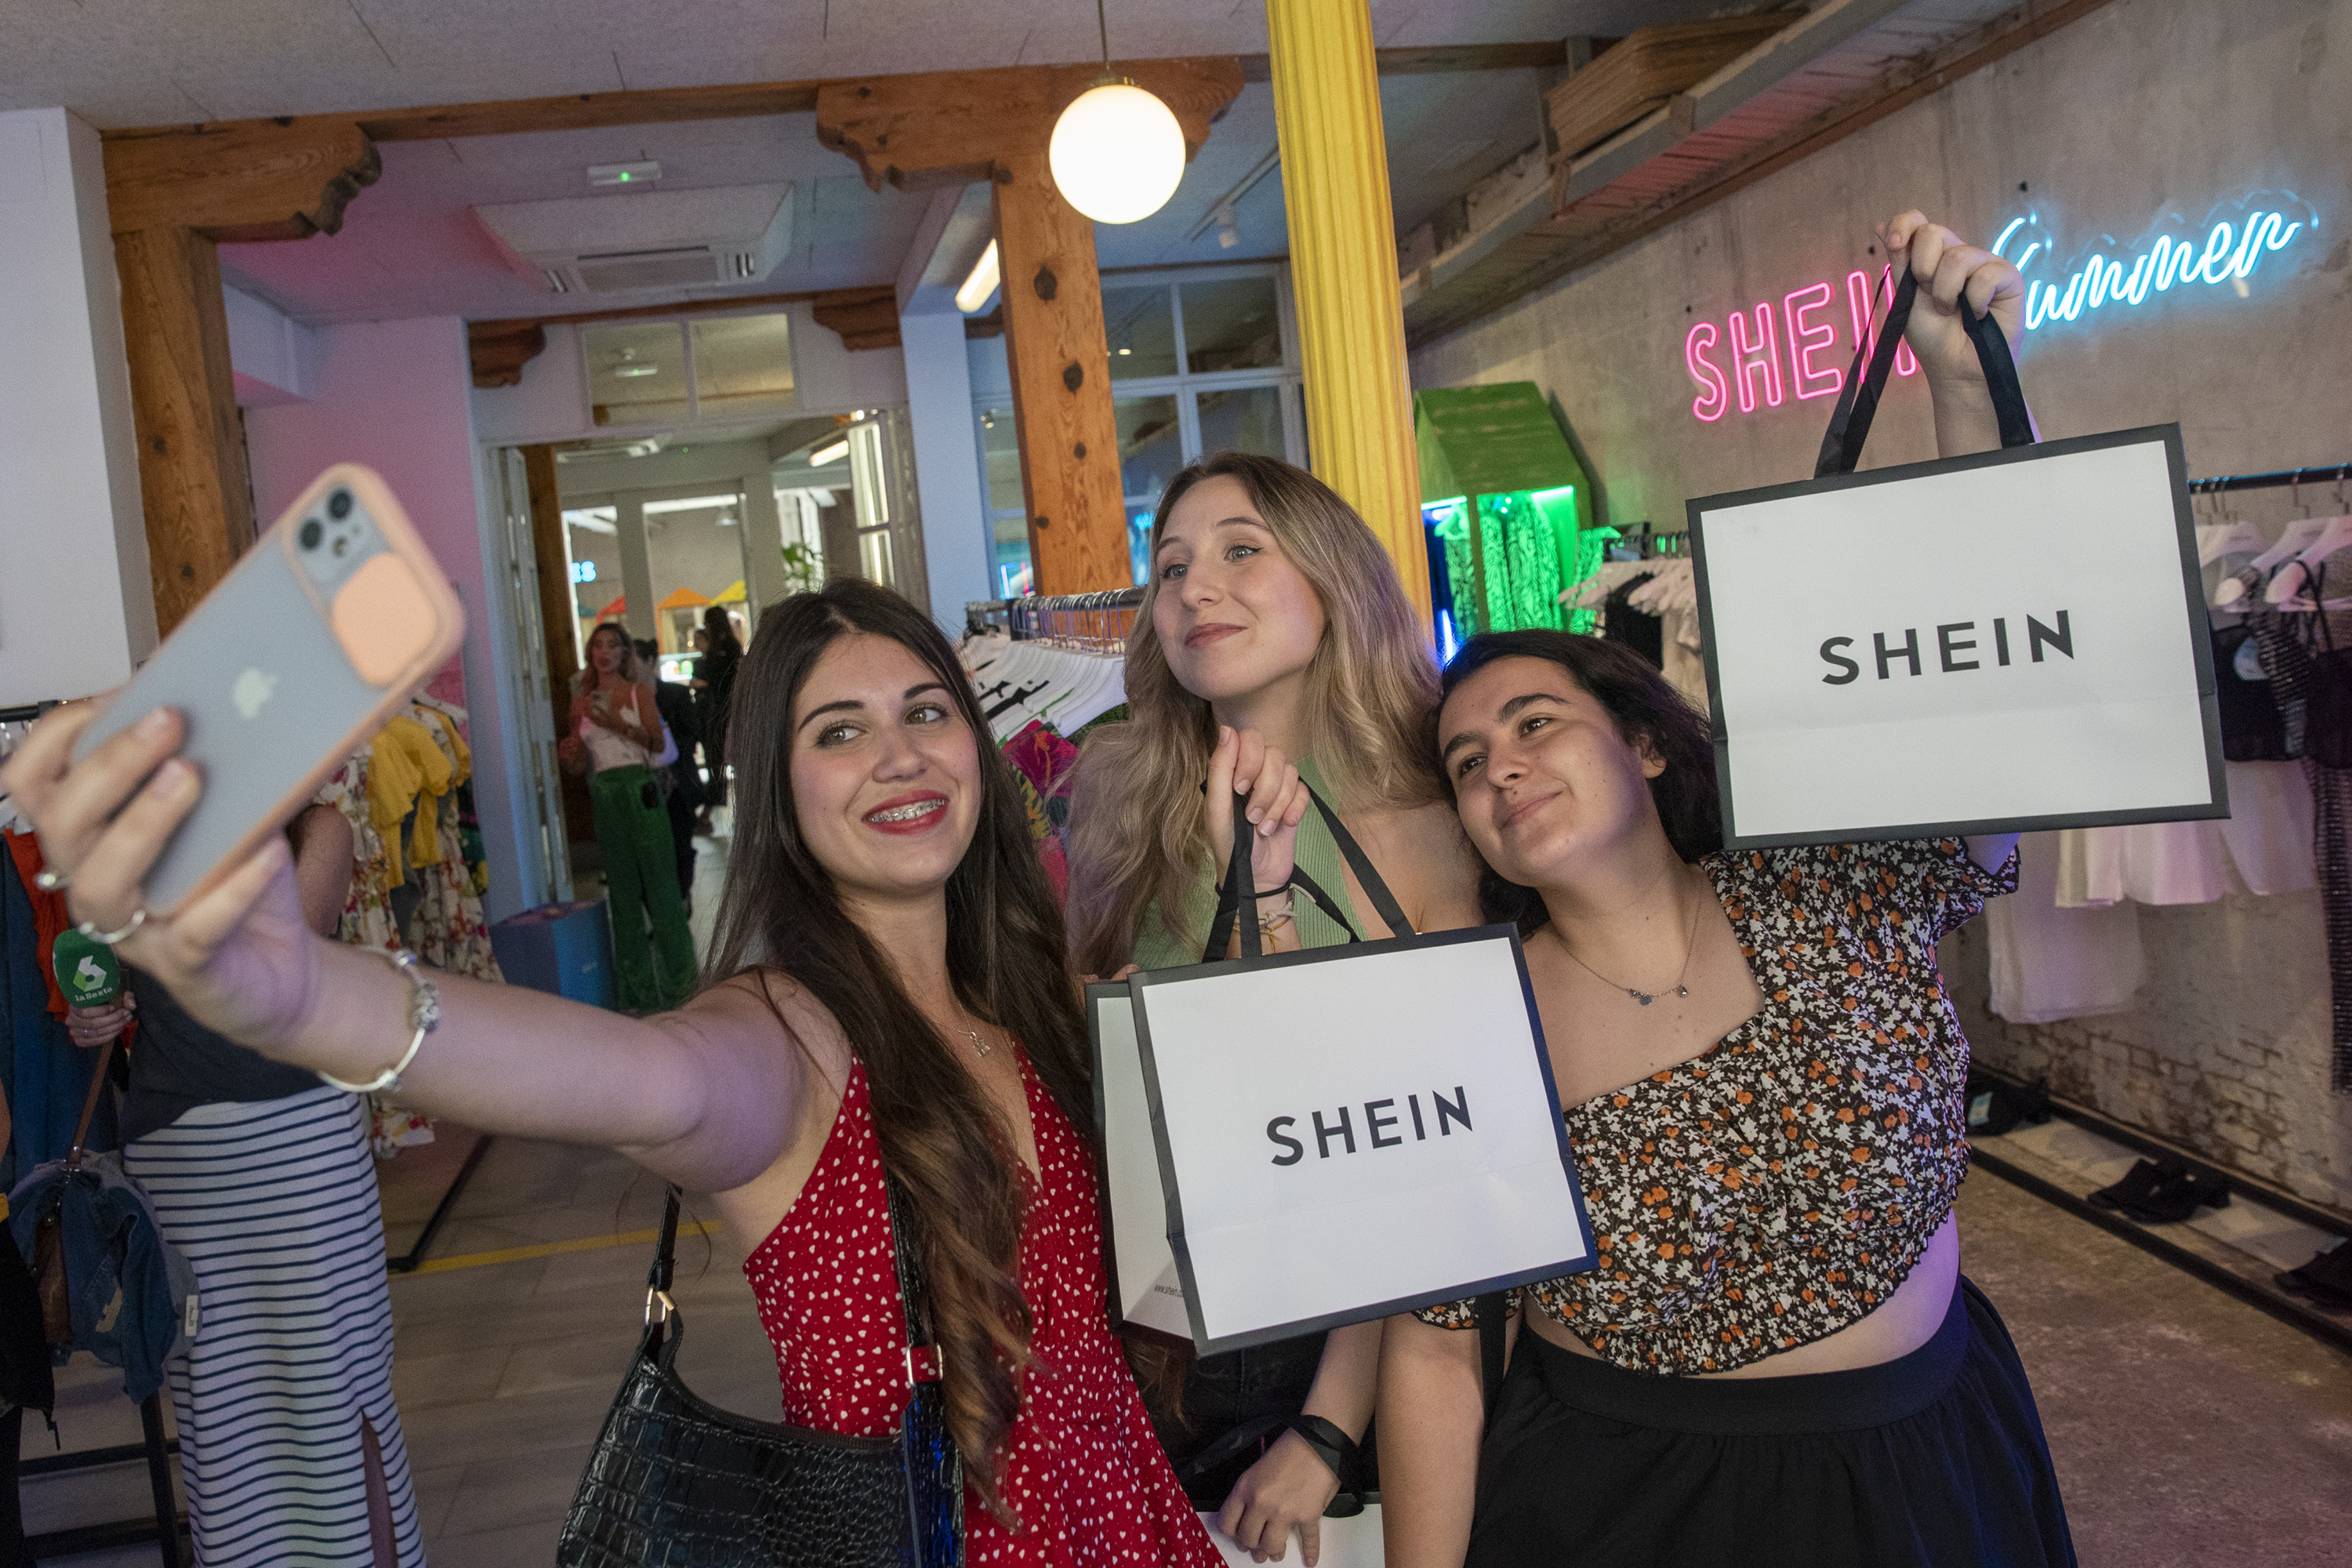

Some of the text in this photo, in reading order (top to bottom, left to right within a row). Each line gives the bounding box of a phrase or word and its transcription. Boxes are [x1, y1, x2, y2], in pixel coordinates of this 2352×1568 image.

[1820, 609, 2074, 685] SHEIN
[74, 987, 113, 1001] laSexta
[1267, 1085, 1473, 1167] SHEIN
